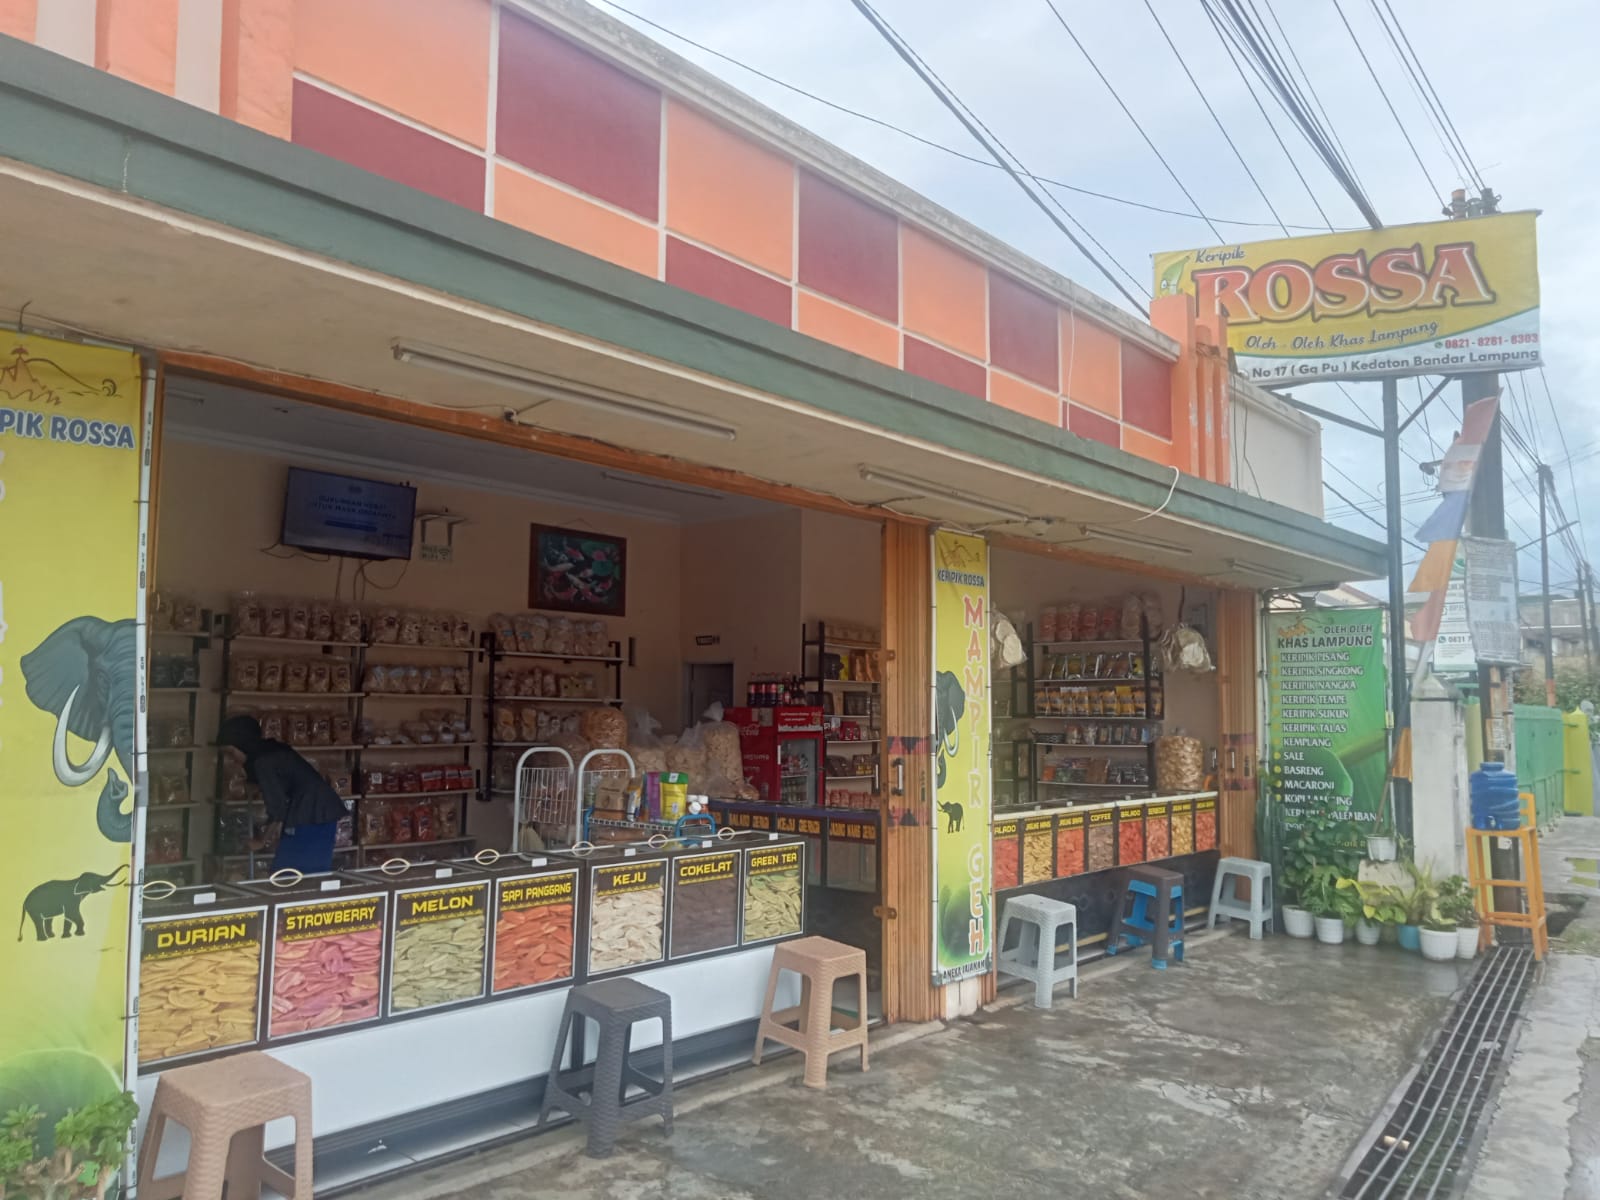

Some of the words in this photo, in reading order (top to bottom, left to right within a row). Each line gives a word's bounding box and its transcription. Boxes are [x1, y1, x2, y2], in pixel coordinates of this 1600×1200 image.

[1195, 245, 1246, 266] Keripik
[1192, 242, 1496, 324] ROSSA
[1246, 335, 1277, 350] Oleh
[1292, 335, 1325, 350] Oleh
[1329, 333, 1365, 348] Khas
[1369, 319, 1439, 344] Lampung
[1445, 339, 1470, 349] 0821
[1252, 367, 1271, 378] No
[1275, 366, 1287, 377] 17
[1322, 362, 1339, 373] Pu
[1351, 358, 1409, 371] Kedaton
[1413, 353, 1466, 367] Bandar
[1469, 350, 1539, 363] Lampung
[51, 415, 135, 449] ROSSA
[963, 574, 984, 586] ROSSA
[1323, 626, 1347, 634] OLEH
[1349, 624, 1373, 633] OLEH
[1278, 637, 1309, 649] KHAS
[1312, 635, 1373, 648] LAMPUNG
[1318, 665, 1364, 676] SINGKONG
[1318, 680, 1357, 689] NANGKA
[1319, 695, 1345, 704] TEMPE
[1319, 709, 1349, 719] SUKUN
[1283, 724, 1316, 732] KERIPIK
[1319, 723, 1346, 732] TALAS
[1283, 738, 1332, 747] KEMPLANG
[1283, 752, 1305, 760] SALE
[1284, 766, 1324, 776] BASRENG
[1285, 780, 1335, 790] MACARONI
[1090, 813, 1111, 822] COFFEE
[994, 825, 1016, 834] ALADO
[751, 856, 778, 867] GREEN
[782, 853, 797, 863] TEA
[680, 861, 732, 877] COKELAT
[613, 871, 647, 887] KEJU
[502, 887, 523, 903] SAPI
[526, 882, 572, 900] PANGGANG
[412, 895, 473, 915] MELON
[286, 906, 376, 930] STROWBERRY
[157, 923, 247, 948] DURIAN
